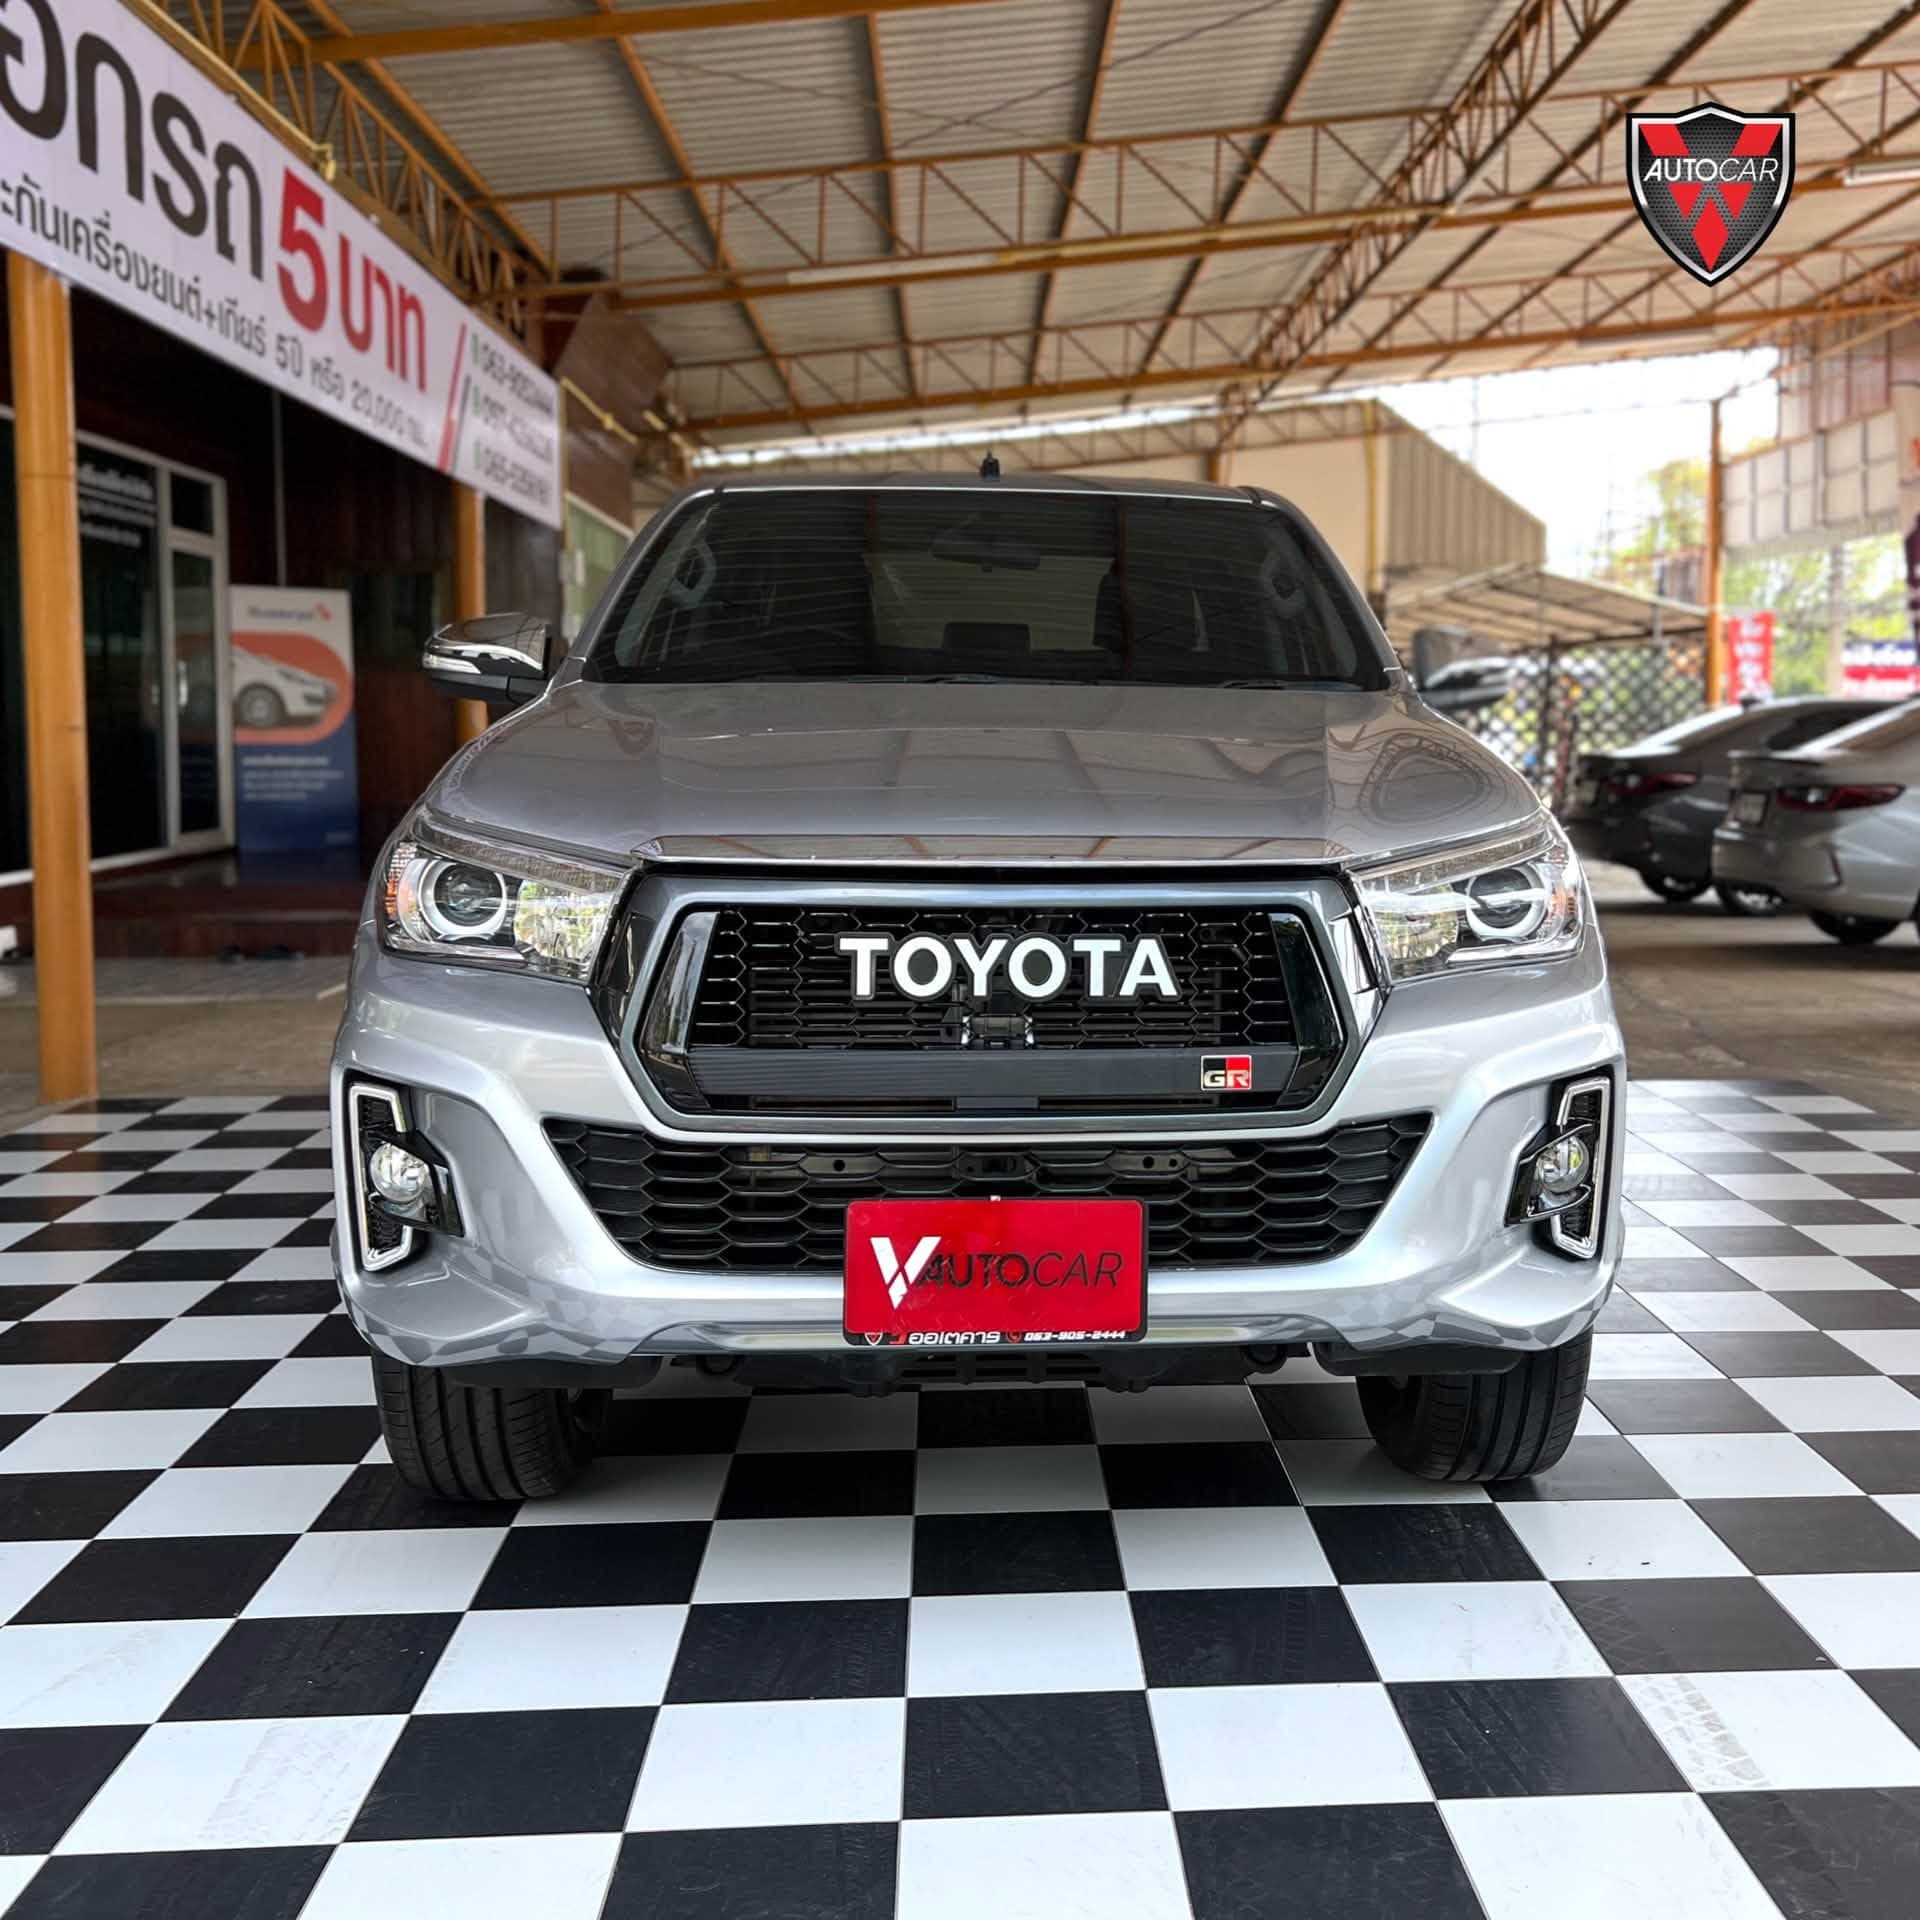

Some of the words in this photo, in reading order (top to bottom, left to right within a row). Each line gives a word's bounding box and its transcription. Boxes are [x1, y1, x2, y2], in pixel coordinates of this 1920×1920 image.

[839, 936, 1178, 999] TOYOTA
[1204, 1070, 1249, 1087] GR
[918, 1252, 1124, 1288] AUTOCAR
